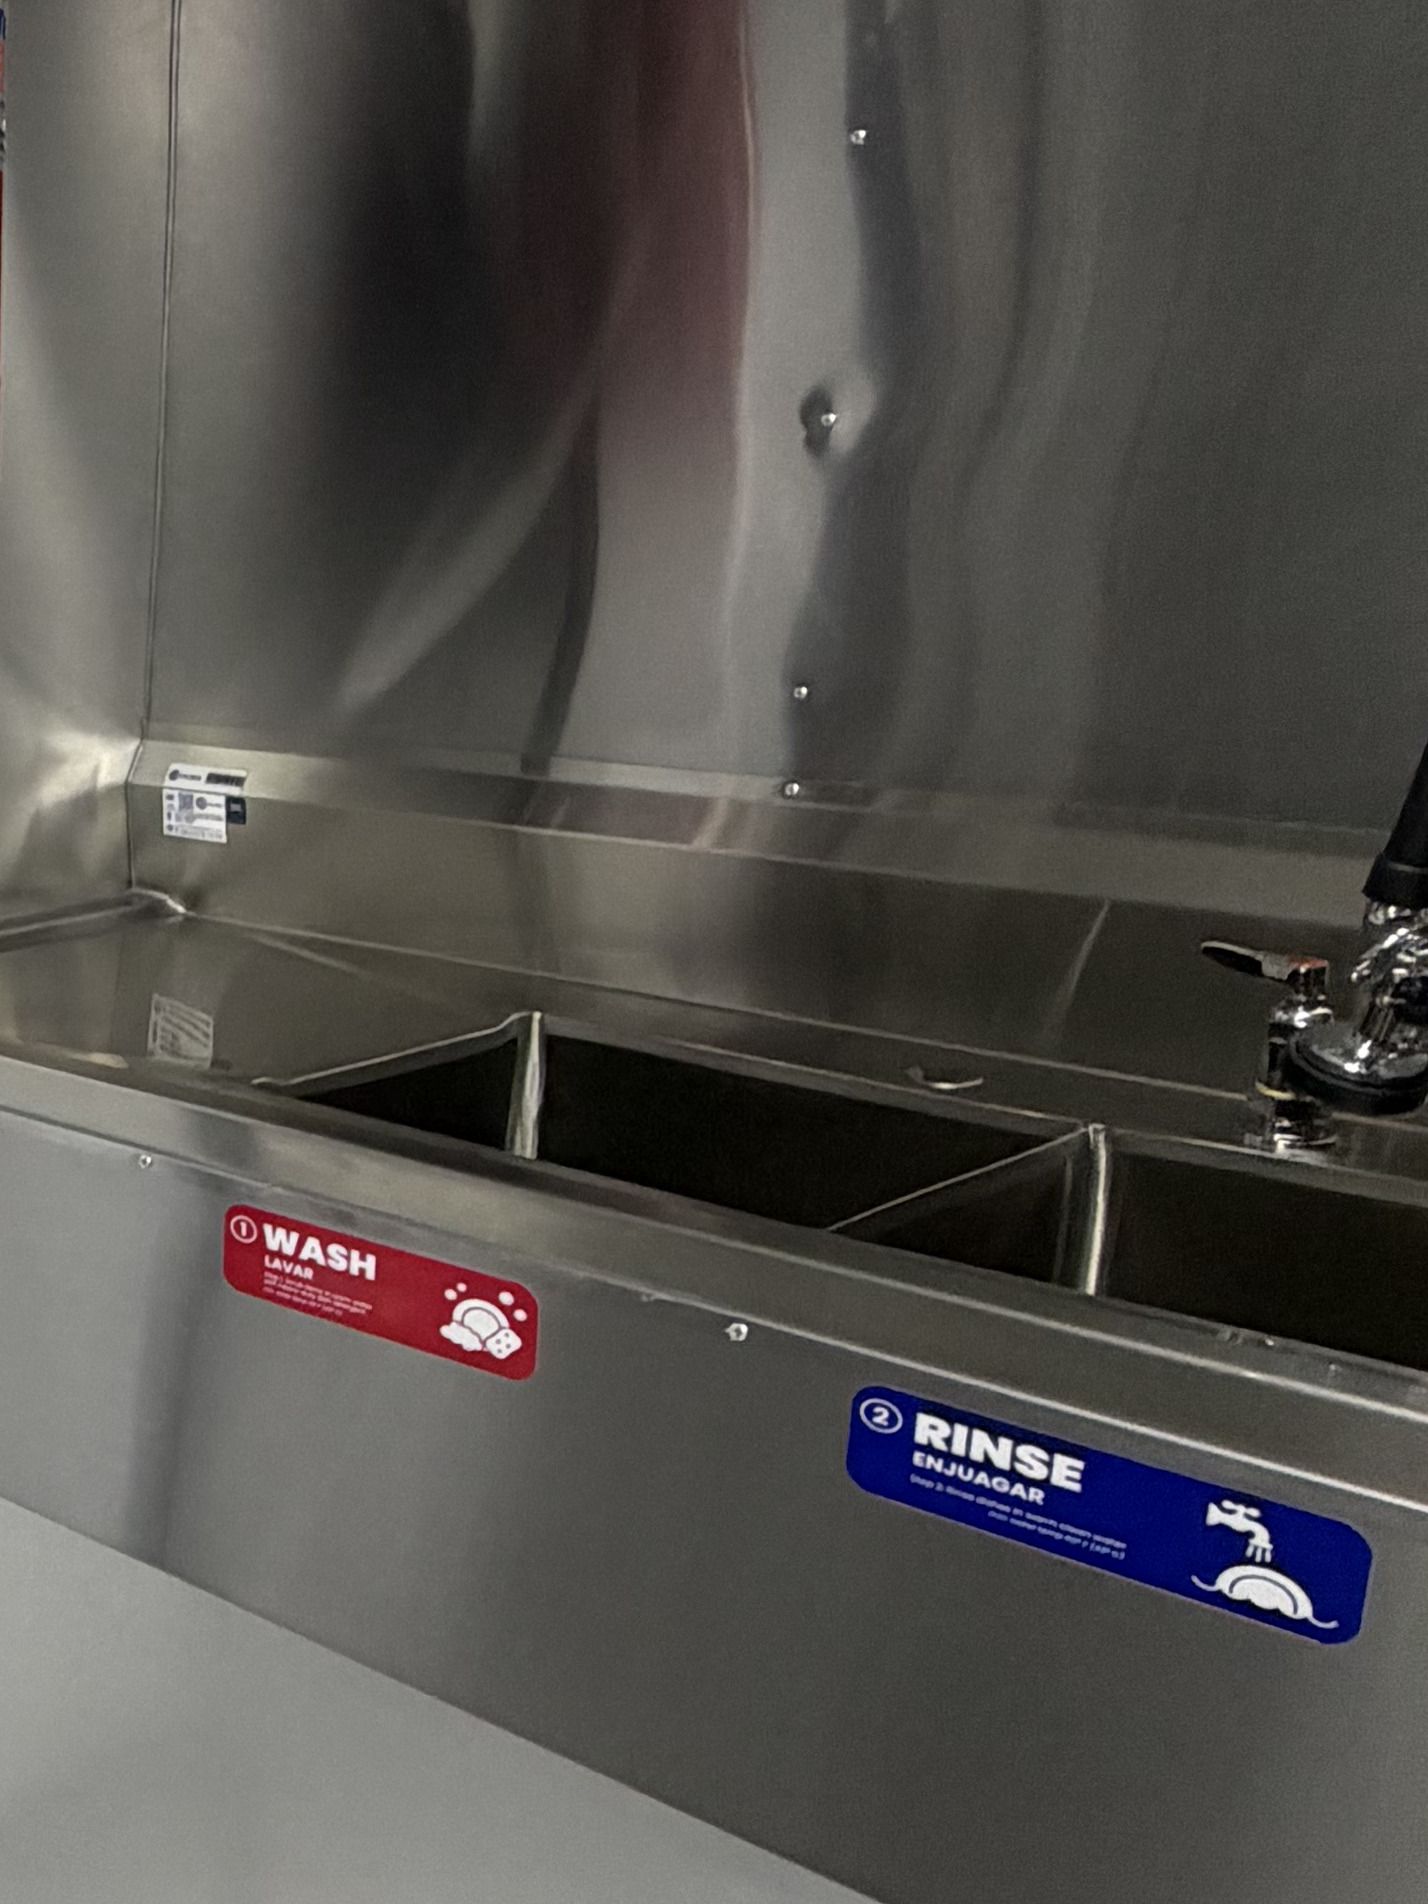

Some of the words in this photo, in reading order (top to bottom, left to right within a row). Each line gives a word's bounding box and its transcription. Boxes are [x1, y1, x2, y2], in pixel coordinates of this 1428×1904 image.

[262, 1222, 377, 1281] WASH
[263, 1254, 315, 1280] LAVAR
[912, 1449, 1046, 1506] ENJUAGAR
[913, 1411, 1086, 1494] RINSE
